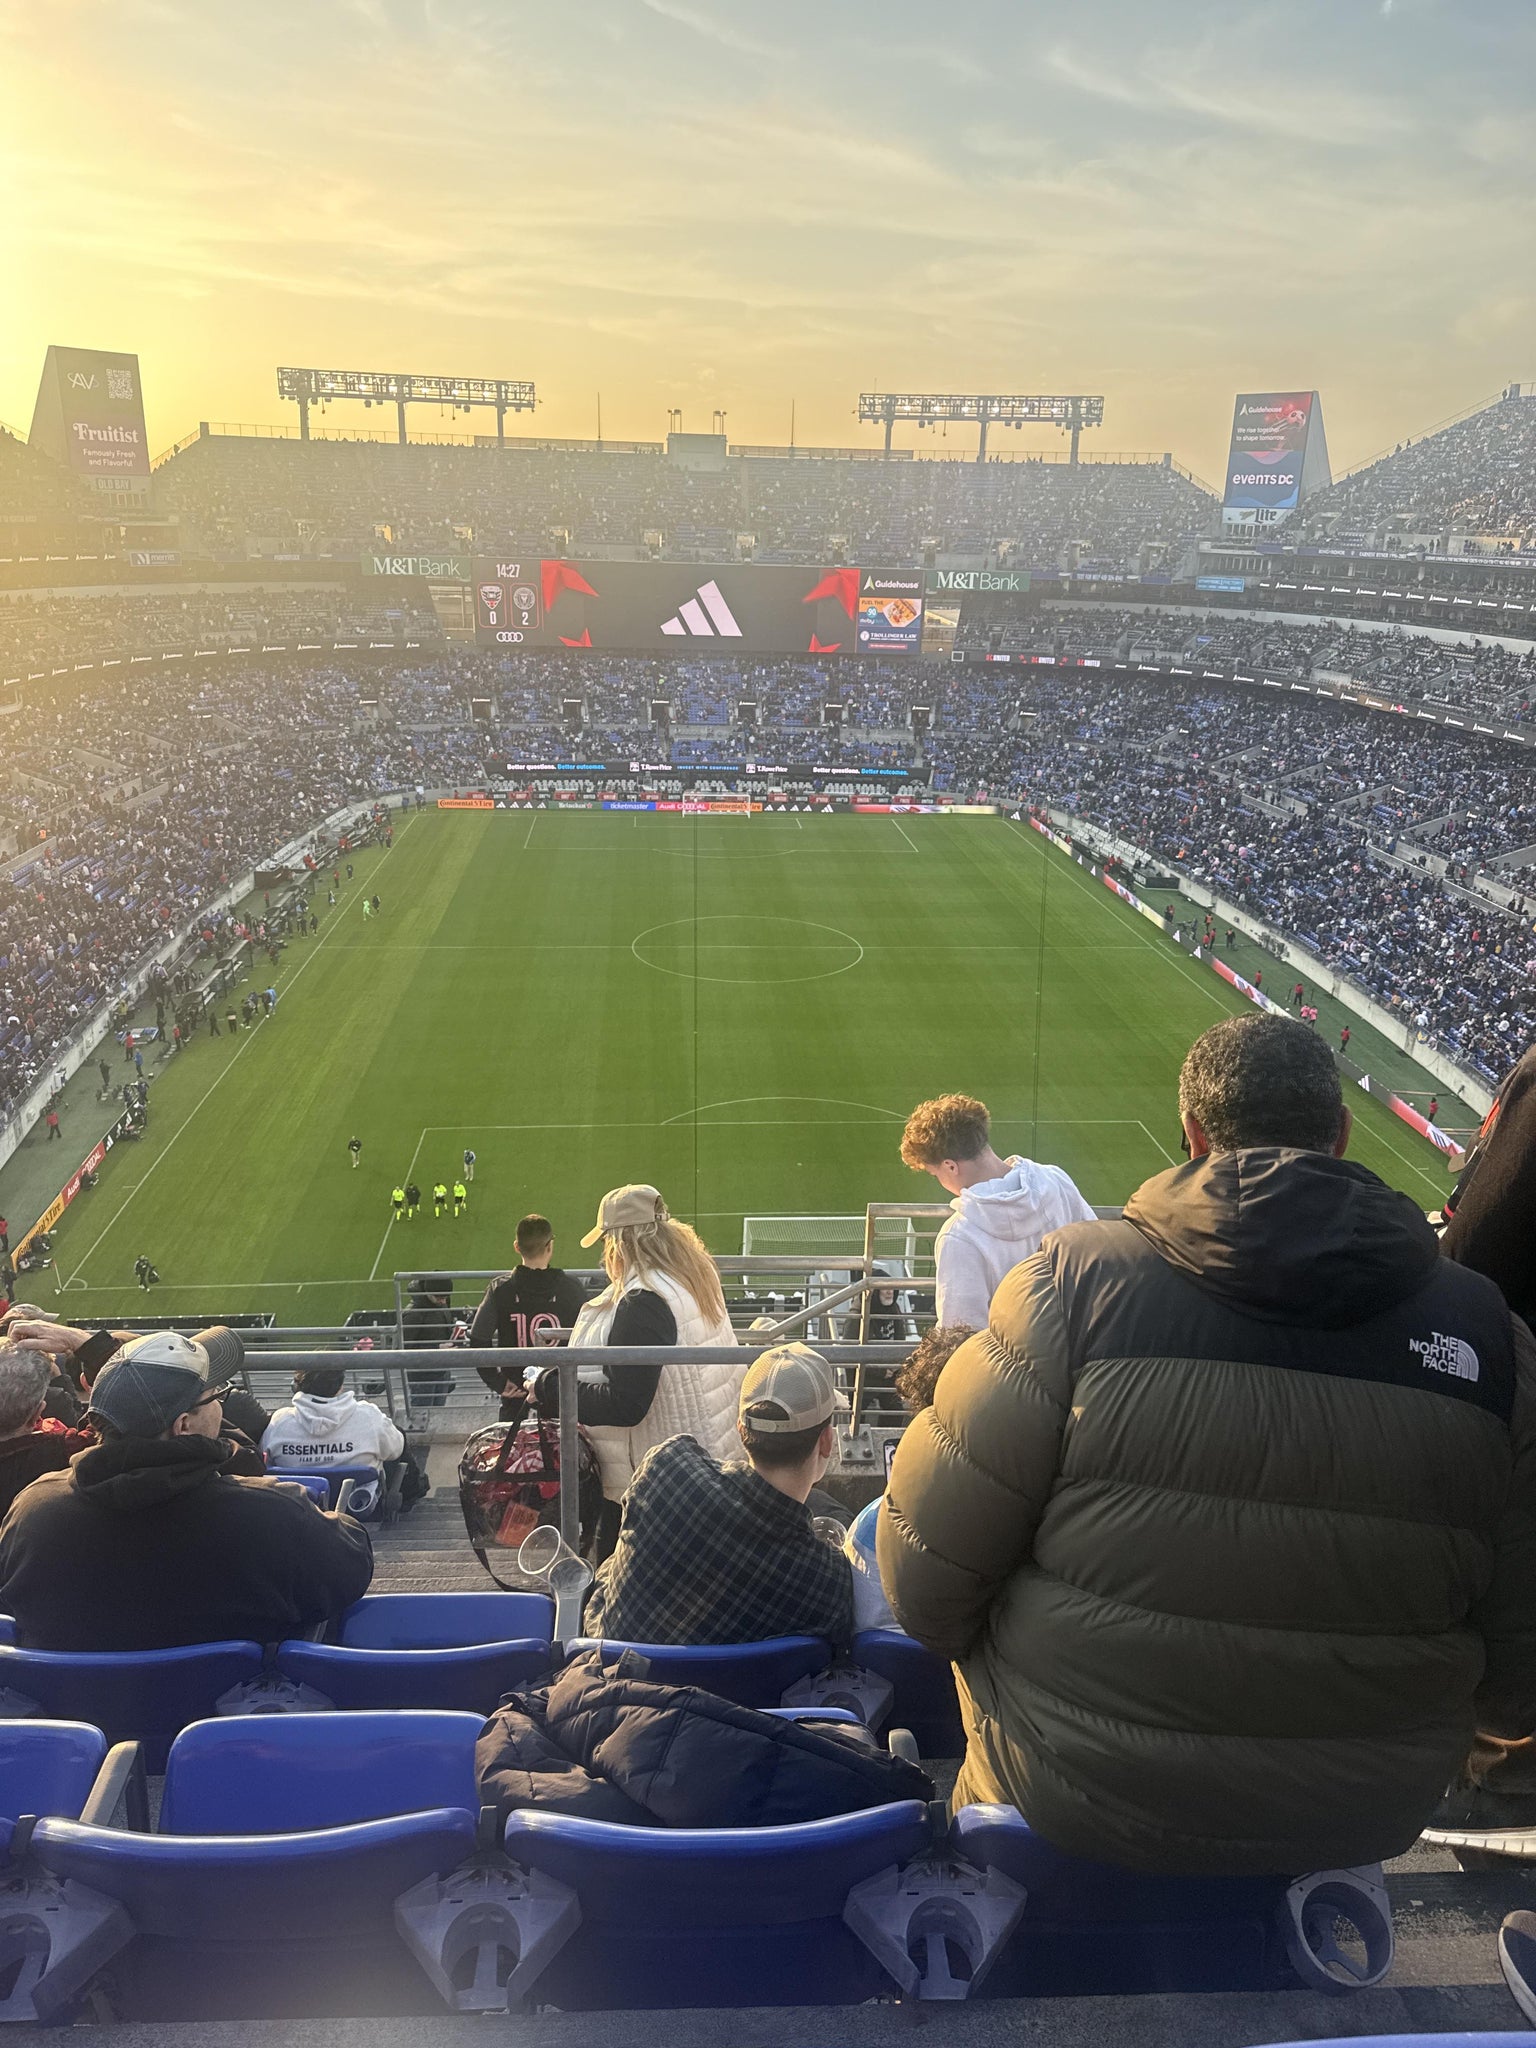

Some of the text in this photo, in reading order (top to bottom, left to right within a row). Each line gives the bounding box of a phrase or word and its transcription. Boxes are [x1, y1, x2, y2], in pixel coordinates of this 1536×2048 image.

[72, 422, 139, 443] Fruitist
[82, 448, 136, 458] Famously Fresh
[103, 459, 133, 467] Flavorful
[98, 479, 130, 490] OLD BAY
[1255, 508, 1277, 524] Lite
[373, 557, 460, 576] M&T Bank
[496, 563, 520, 578] 14:27
[875, 580, 919, 589] Guidehouse
[936, 571, 1020, 591] M&T Bank
[489, 611, 497, 625] 0
[522, 611, 529, 626] 2
[67, 1176, 80, 1199] Audi
[509, 1312, 561, 1348] 10
[1431, 1331, 1459, 1350] THE
[1408, 1338, 1457, 1363] NORTH
[1422, 1355, 1457, 1375] FACE
[282, 1442, 353, 1456] ESSENTIALS
